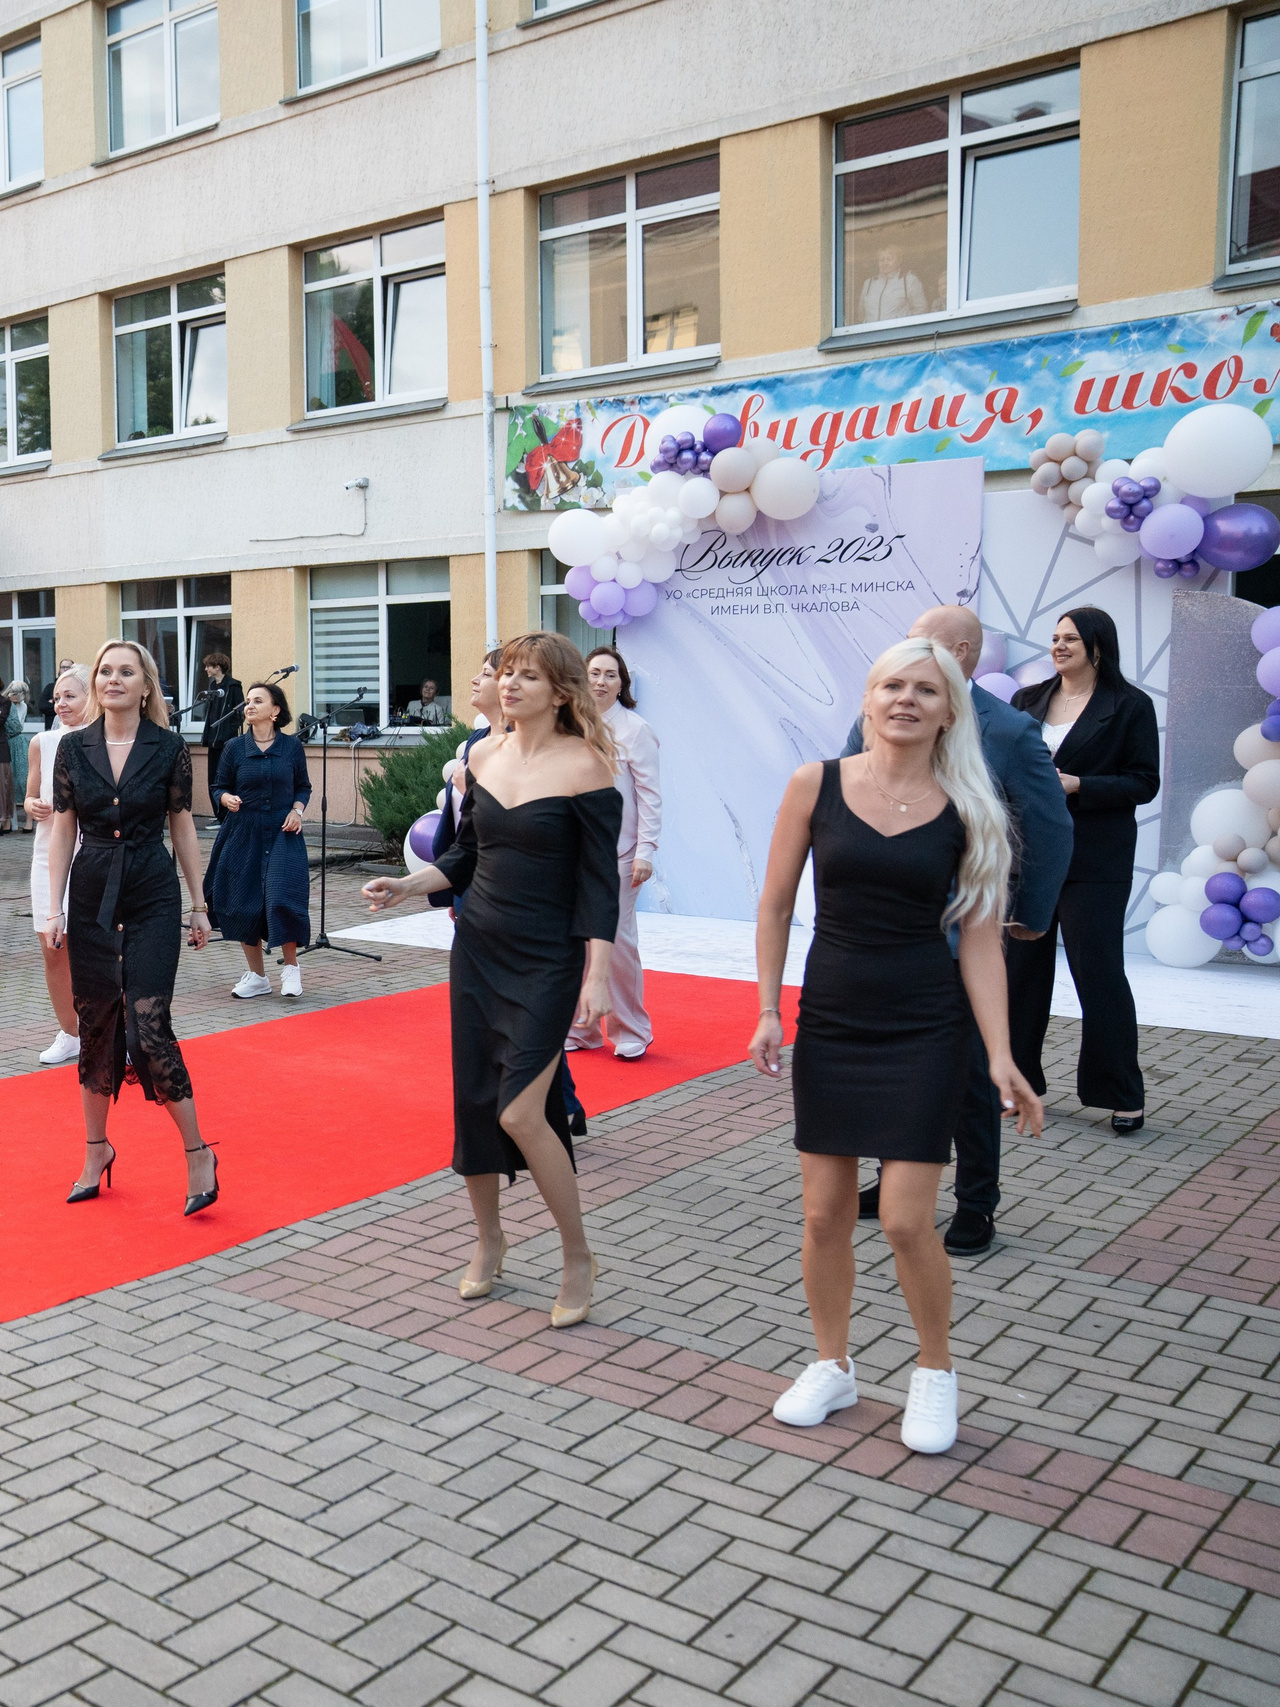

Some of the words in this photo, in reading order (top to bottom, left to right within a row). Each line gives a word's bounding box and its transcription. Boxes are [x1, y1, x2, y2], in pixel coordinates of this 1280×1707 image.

[674, 529, 816, 585] Выпуск
[814, 533, 906, 565] 2025
[665, 589, 683, 600] УО
[685, 586, 753, 600] «СРЕДНЯЯ
[756, 584, 808, 598] ШКОЛА
[851, 580, 916, 593] МИНСКА
[710, 604, 759, 616] ИМЕНИ
[763, 603, 788, 615] В.П.
[791, 601, 861, 614] ЧКАЛОВА
